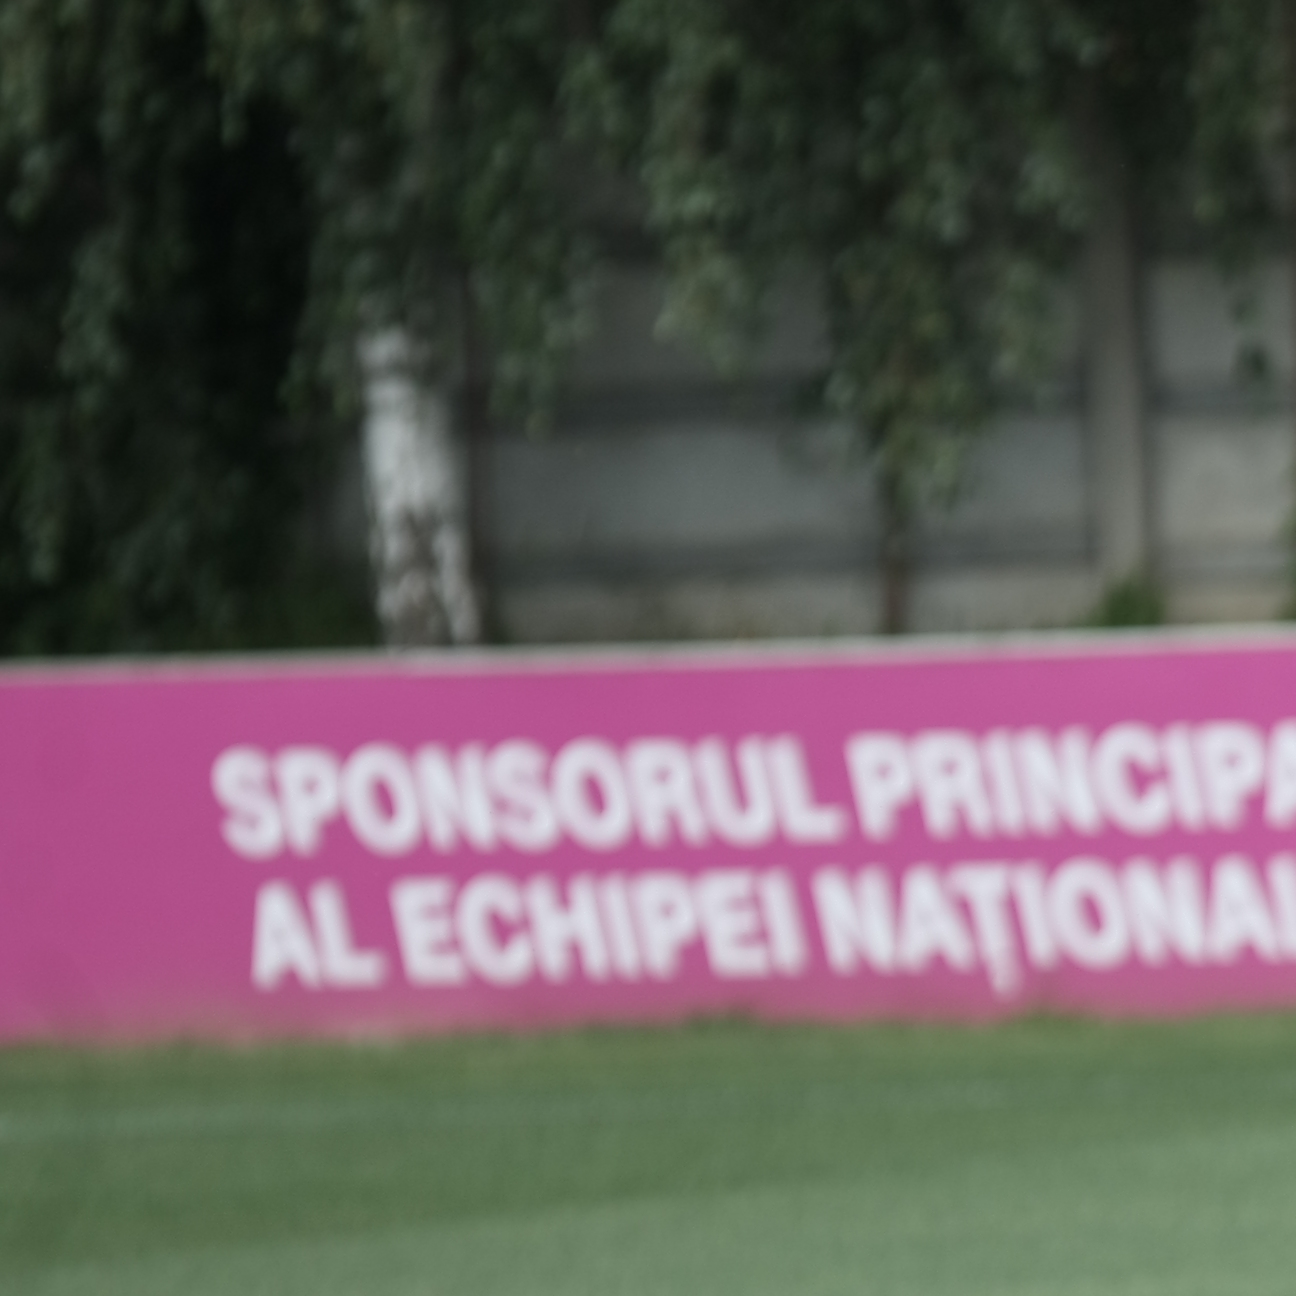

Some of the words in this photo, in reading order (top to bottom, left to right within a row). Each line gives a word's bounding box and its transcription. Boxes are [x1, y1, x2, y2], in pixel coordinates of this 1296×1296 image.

[212, 735, 848, 858] SPONSORUL
[251, 879, 388, 991] AL
[391, 866, 804, 987] ECHIPEI
